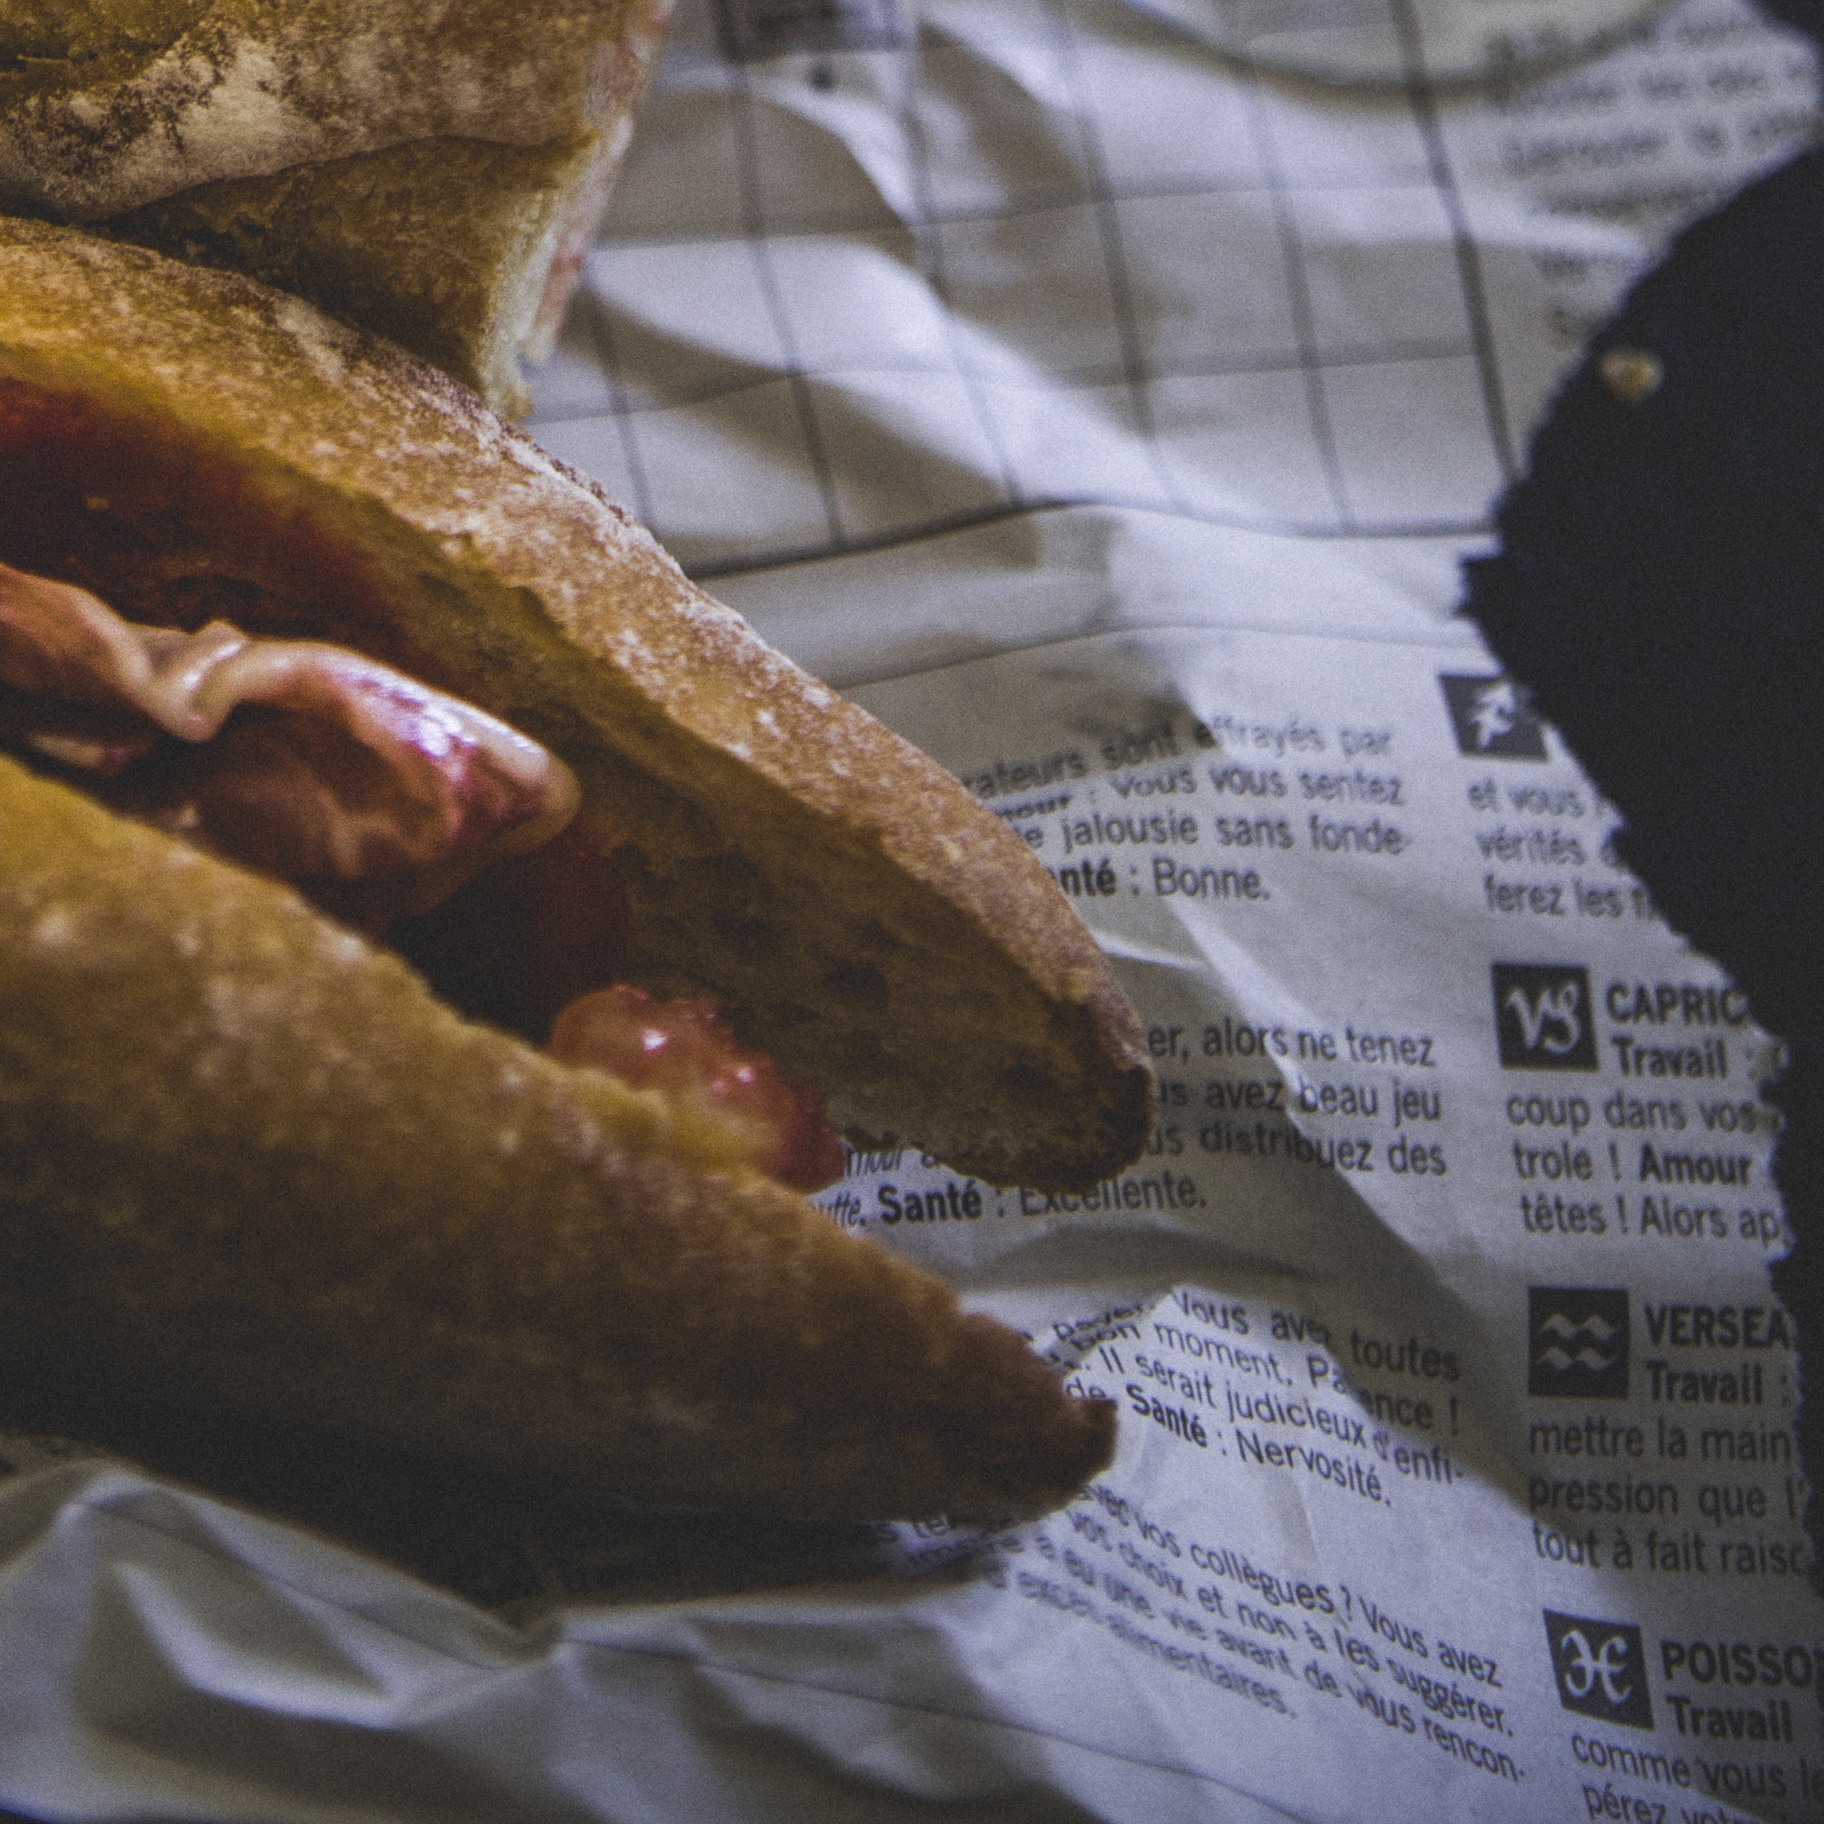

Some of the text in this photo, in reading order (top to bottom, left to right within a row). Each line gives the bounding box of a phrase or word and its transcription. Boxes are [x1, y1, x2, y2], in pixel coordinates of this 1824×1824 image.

[1338, 728, 1392, 757] par
[1298, 772, 1404, 807] sentez
[1506, 789, 1585, 819] vous
[1061, 812, 1198, 854] jalousie
[1214, 815, 1294, 850] sans
[1309, 814, 1413, 857] fonde-
[1046, 855, 1117, 898] nté
[1152, 858, 1271, 901] Bonne.
[1484, 872, 1565, 918] ferez
[1572, 876, 1624, 919] les
[1203, 1016, 1288, 1057] alors
[1298, 1031, 1337, 1058] ne
[1346, 1027, 1437, 1068] tenez
[1610, 1034, 1728, 1079] Travail
[1206, 1078, 1283, 1112] avez
[1298, 1073, 1379, 1118] beau
[1390, 1078, 1442, 1128] jeu
[1505, 1090, 1593, 1137] coup
[1603, 1089, 1687, 1131] dans
[1199, 1120, 1374, 1172] distribuez
[1388, 1135, 1449, 1178] des
[1513, 1139, 1594, 1182] trole
[1639, 1143, 1752, 1187] Amour
[879, 1177, 981, 1226] Santé
[1521, 1192, 1608, 1236] têtes
[1640, 1194, 1728, 1240] Alors
[1644, 1303, 1792, 1351] VERSEA
[1152, 1321, 1294, 1387] moment.
[1350, 1325, 1461, 1383] toutes
[1134, 1352, 1218, 1410] serait
[1225, 1376, 1368, 1451] judicieux
[1644, 1359, 1764, 1405] Travail
[1125, 1382, 1208, 1448] Santé
[1234, 1427, 1391, 1507] Nervosité.
[1529, 1415, 1792, 1463] mettre la main
[1528, 1473, 1679, 1516] pression
[1698, 1484, 1768, 1528] que
[1532, 1520, 1601, 1569] tout
[1613, 1528, 1634, 1571] à
[1646, 1528, 1709, 1573] fait
[1189, 1543, 1335, 1617] collègues
[1358, 1595, 1429, 1659] Vous
[1436, 1638, 1503, 1690] avez
[1197, 1585, 1230, 1620] et
[1236, 1601, 1299, 1643] non
[1333, 1627, 1381, 1673] les
[1385, 1656, 1515, 1740] suggérer.
[1215, 1627, 1299, 1681] avant
[1304, 1659, 1343, 1700] de
[1345, 1682, 1417, 1736] vous
[1421, 1716, 1526, 1784] rencon-
[1666, 1694, 1794, 1743] Travail
[1571, 1731, 1692, 1789] comme
[1695, 1756, 1788, 1800] vous
[1582, 1781, 1669, 1824] pérez
